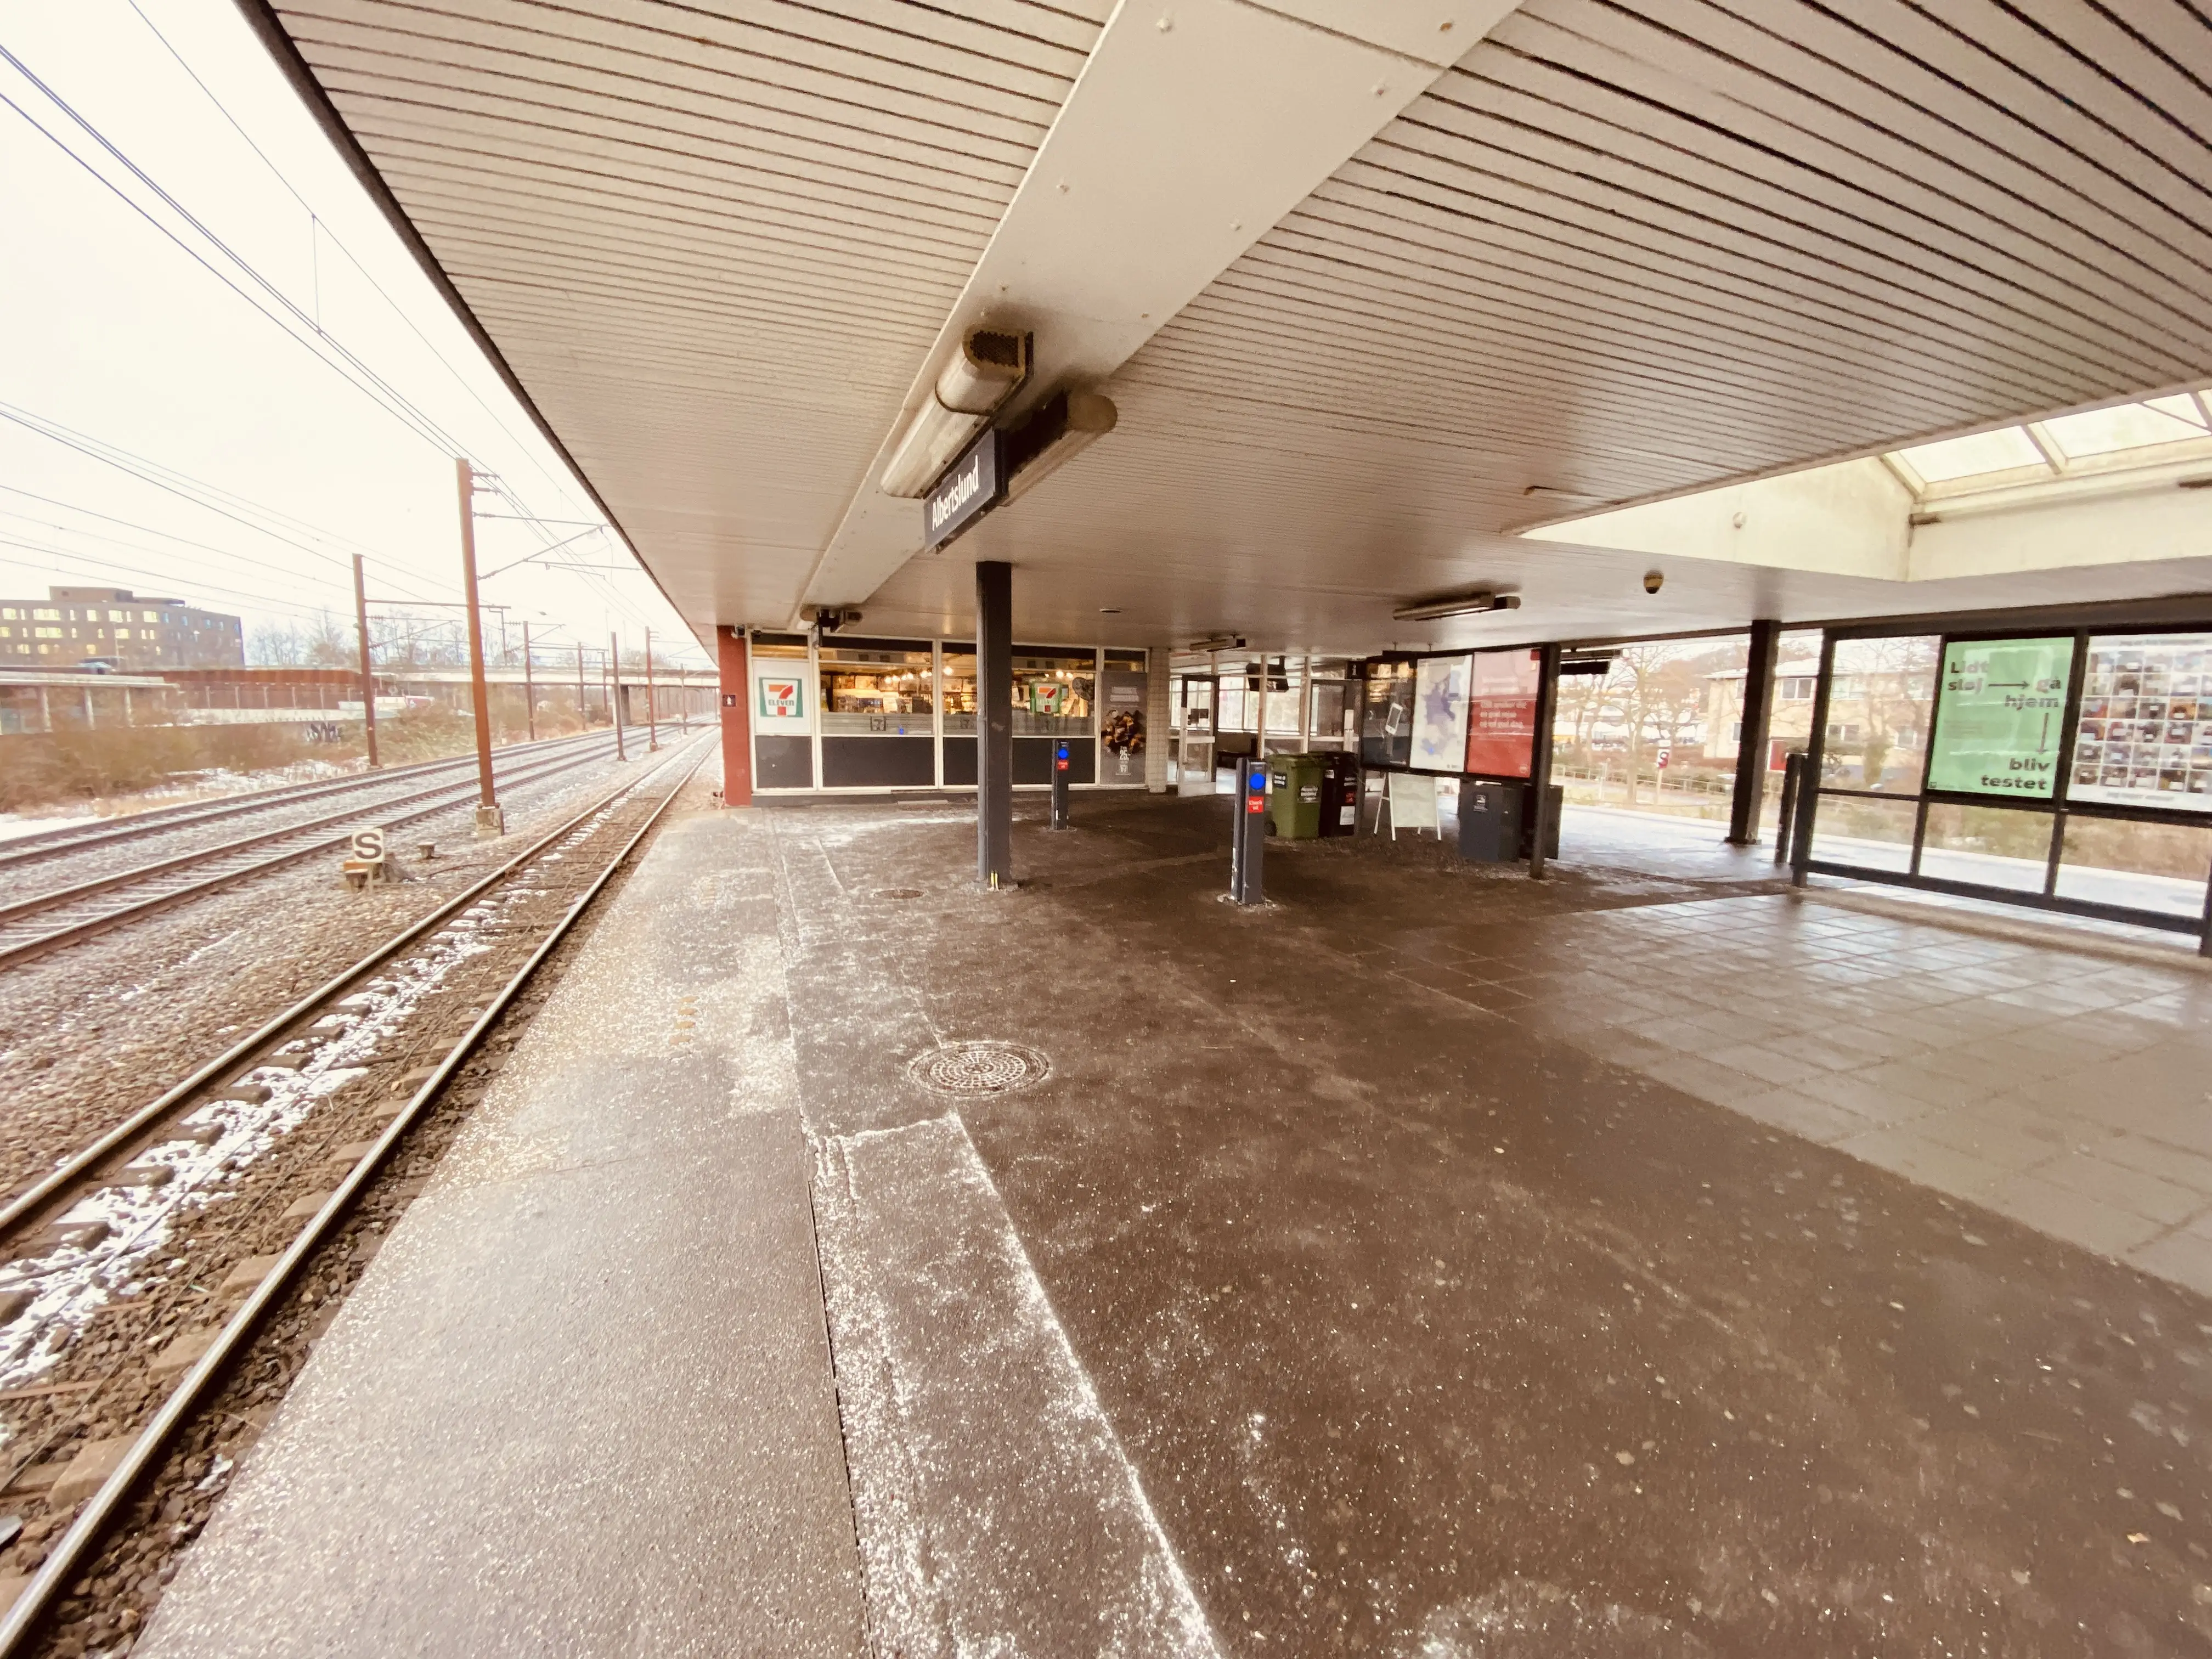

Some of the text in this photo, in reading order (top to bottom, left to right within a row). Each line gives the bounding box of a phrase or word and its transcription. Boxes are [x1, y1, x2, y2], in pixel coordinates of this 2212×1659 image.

[932, 454, 979, 531] Albertslund
[1951, 661, 1989, 674] Lidt
[2005, 695, 2058, 710] hjem
[2010, 758, 2050, 771] bliv
[1981, 775, 2047, 790] testet
[354, 832, 382, 859] S
